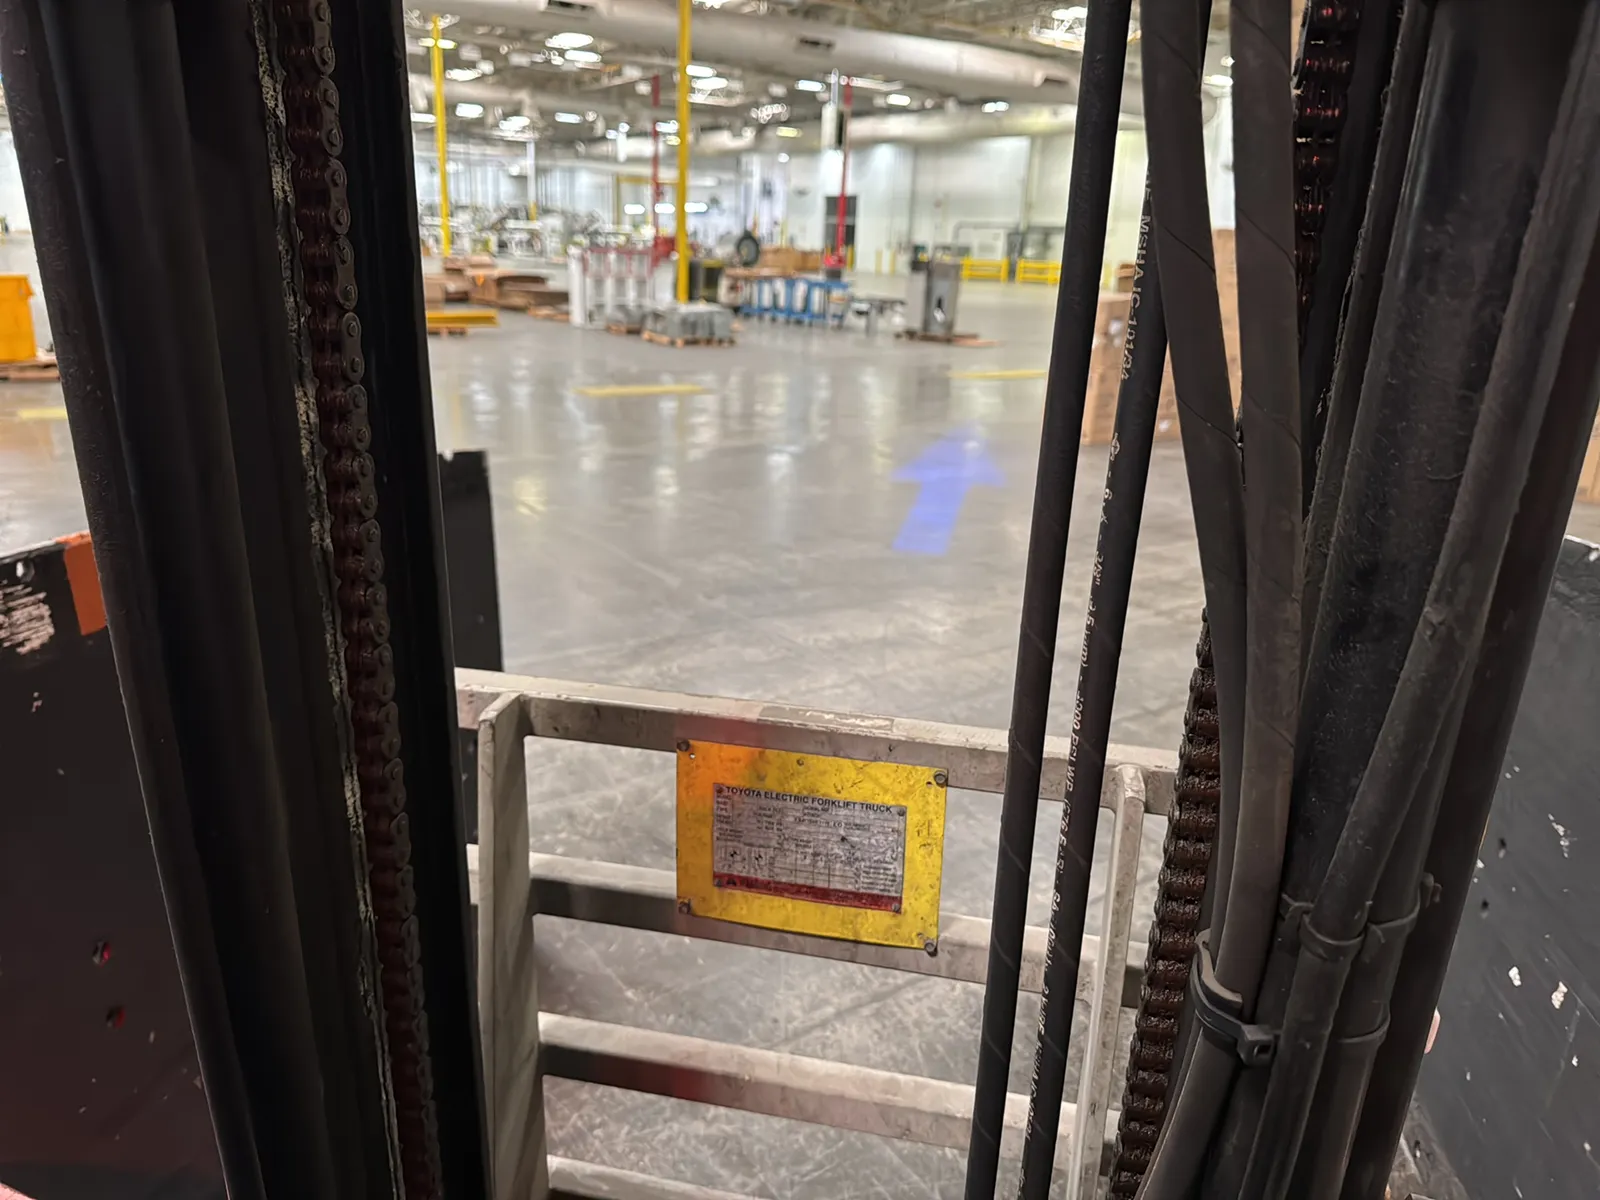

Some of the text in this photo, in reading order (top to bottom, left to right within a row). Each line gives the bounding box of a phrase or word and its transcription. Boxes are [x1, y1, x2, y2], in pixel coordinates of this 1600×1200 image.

[1134, 215, 1151, 281] MSHA
[1069, 732, 1079, 762] PSI
[1066, 763, 1077, 792] WP
[726, 786, 892, 813] TOYOTA ELECTRIC FORKLIFT TRUCK
